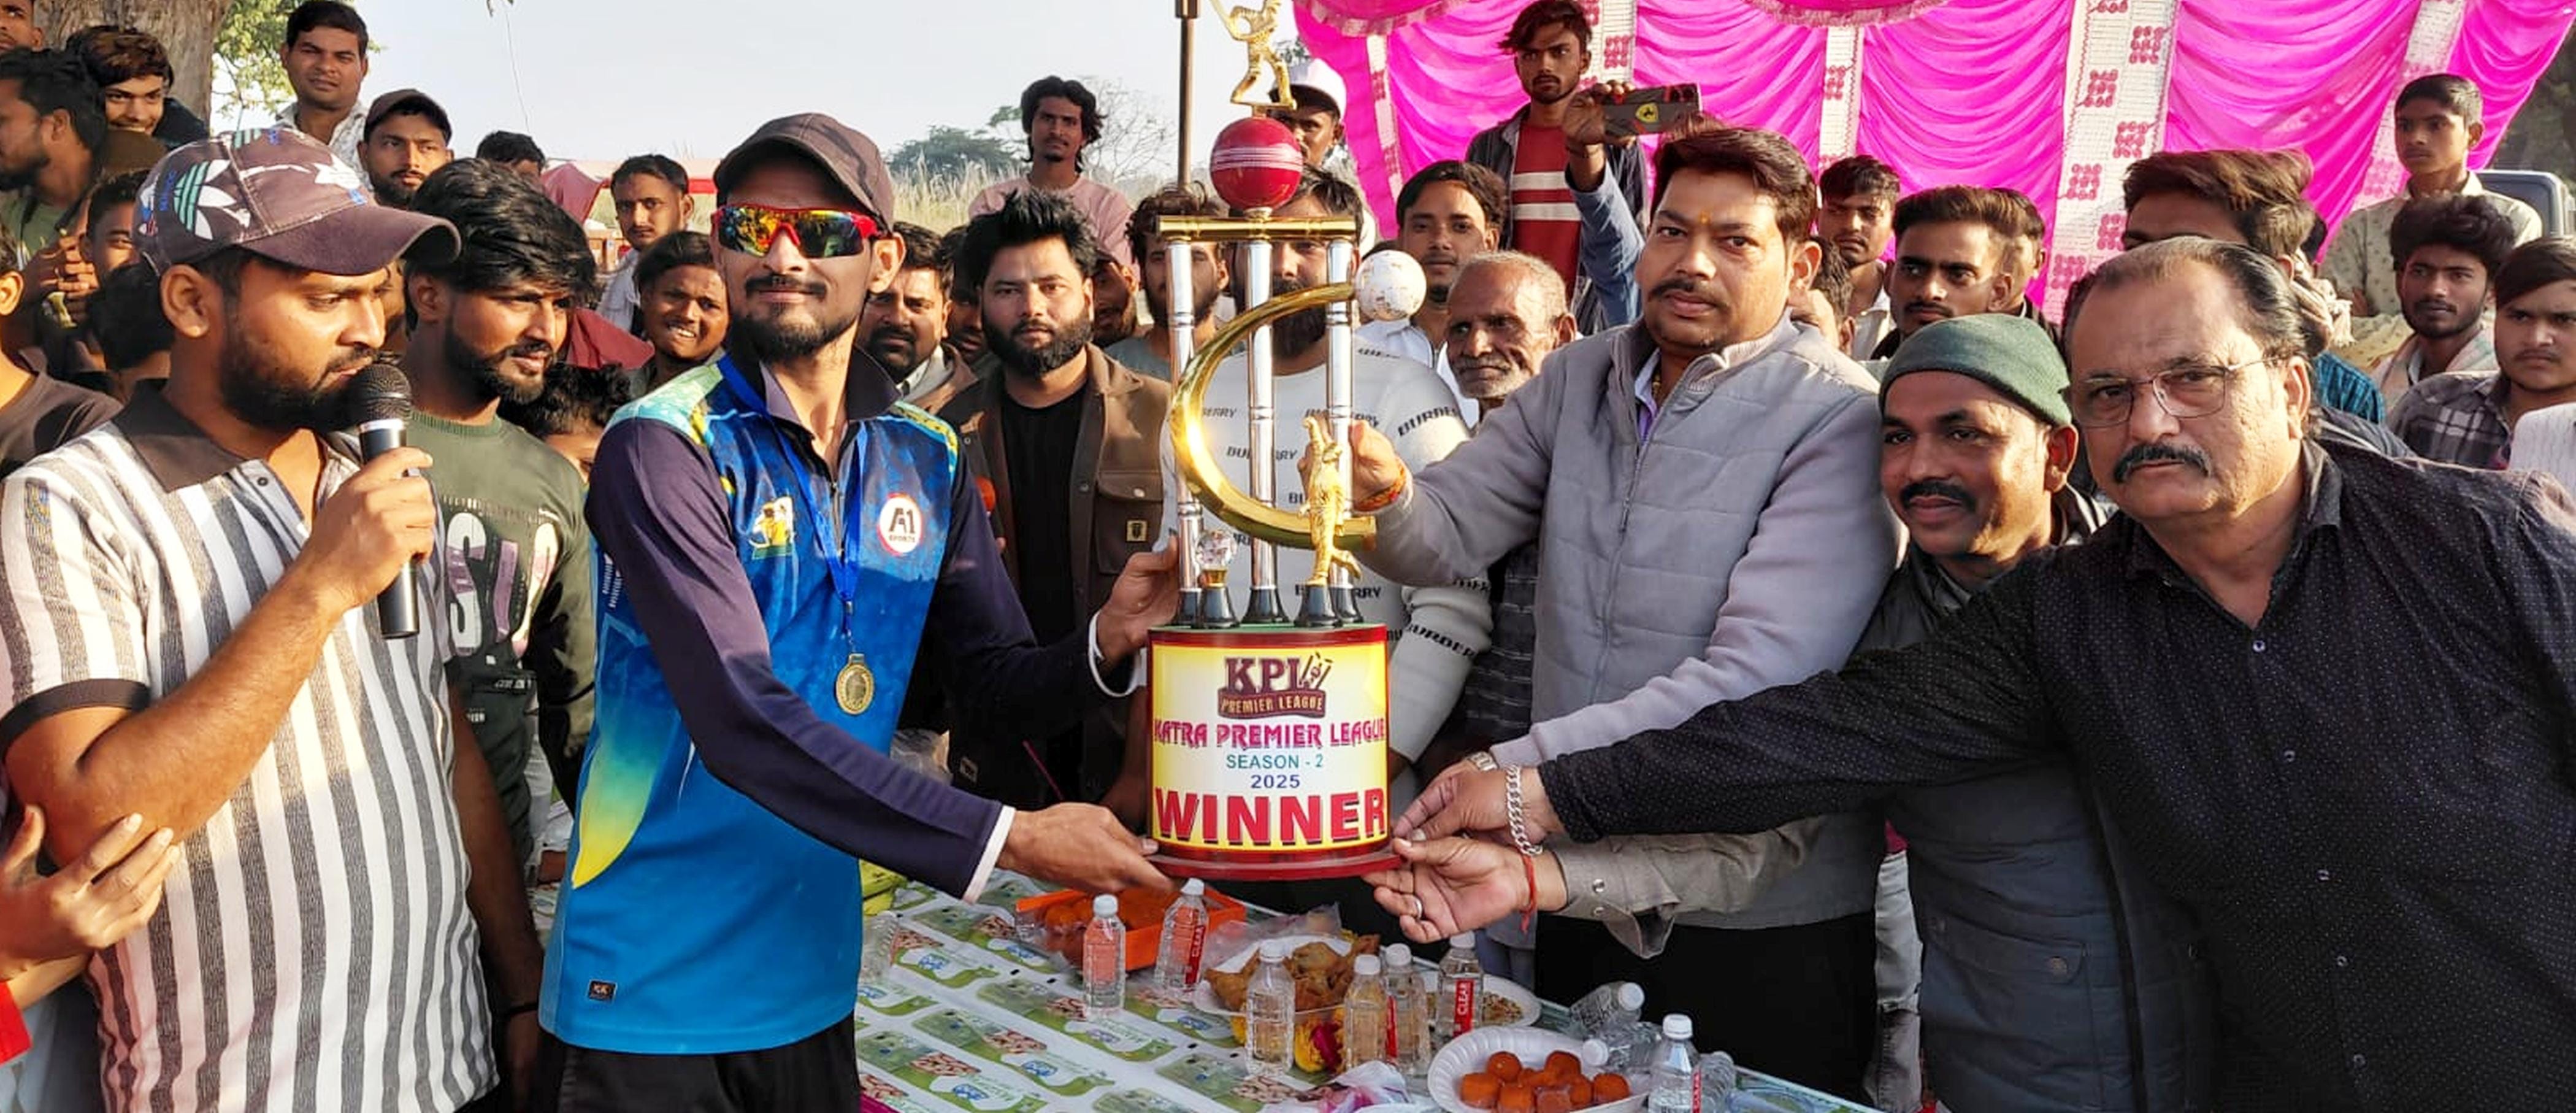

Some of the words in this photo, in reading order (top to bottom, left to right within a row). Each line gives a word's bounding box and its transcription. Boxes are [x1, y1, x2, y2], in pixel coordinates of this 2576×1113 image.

[1221, 698, 1273, 714] PREMIER
[1278, 695, 1323, 712] LEAGUE
[1154, 720, 1208, 749] KATRA
[1217, 723, 1323, 750] PREMIER
[1330, 718, 1384, 747] LEAGUE
[1227, 754, 1299, 769] SEASON
[1315, 753, 1324, 768] 2
[1251, 774, 1301, 789] 2025
[1154, 788, 1386, 845] WINNER
